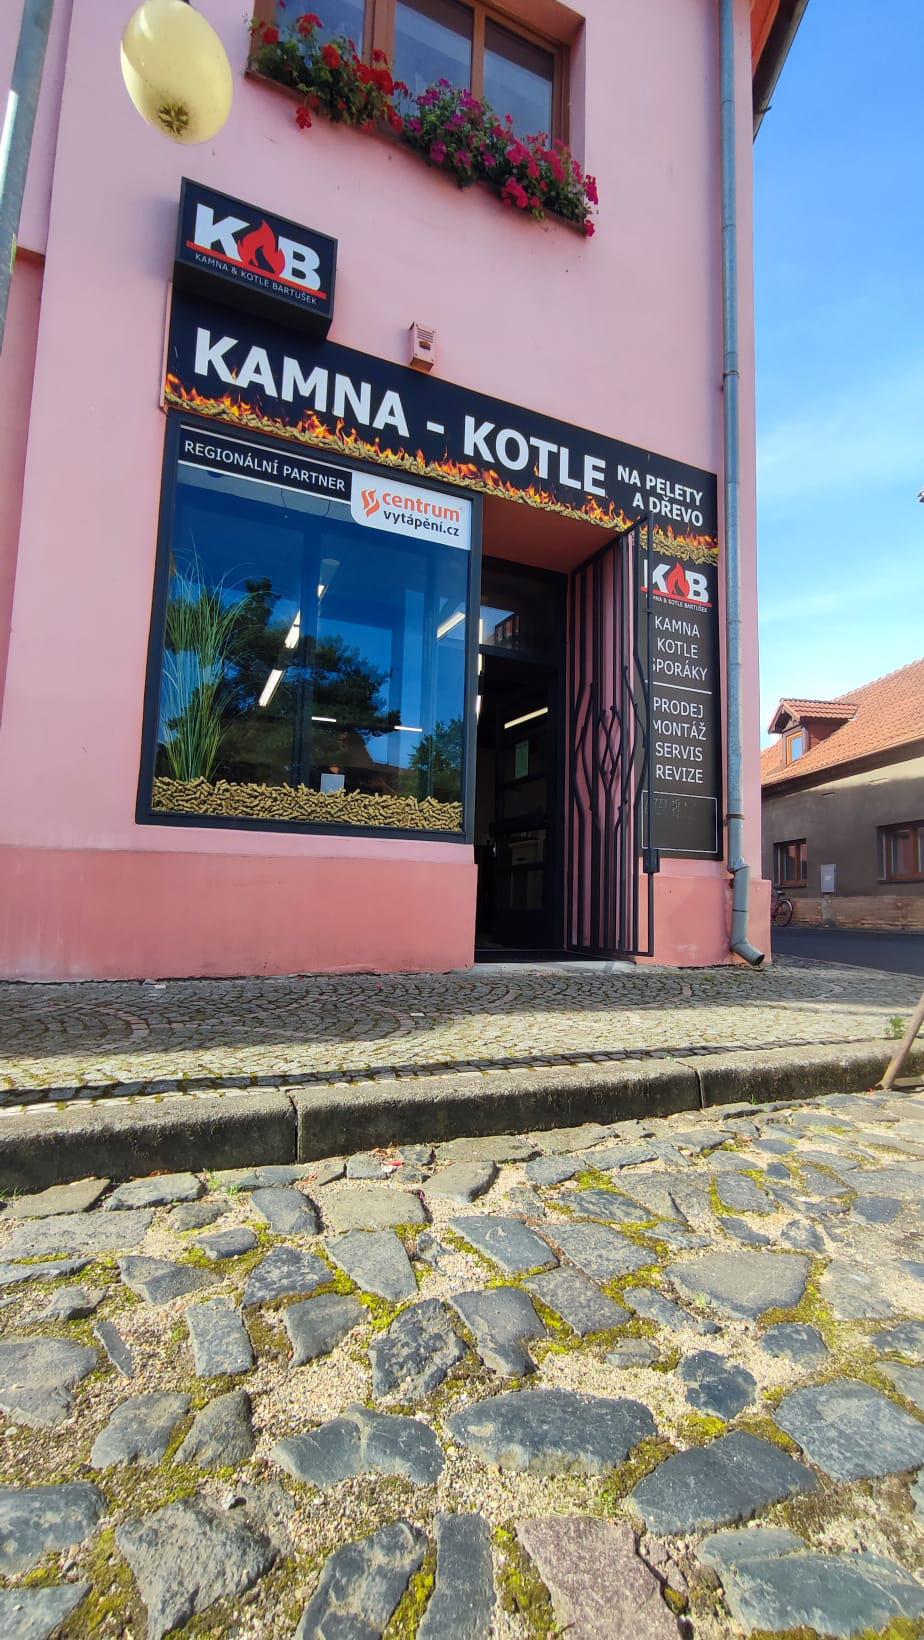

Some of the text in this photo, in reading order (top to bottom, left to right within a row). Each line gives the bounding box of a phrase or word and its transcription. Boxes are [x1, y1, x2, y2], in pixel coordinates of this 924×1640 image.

[195, 253, 318, 305] KAMNA & KOTLE BARTUŠEK
[194, 327, 411, 438] KAMNA
[464, 415, 607, 498] KOTLE
[184, 440, 346, 492] REGIONÁLNÍ PARTNER
[617, 465, 703, 506] NA PELETY
[382, 490, 461, 523] centrum
[632, 492, 704, 527] A DŘEVO
[383, 509, 460, 537] vytápění.cz
[655, 616, 700, 638] KAMNA
[657, 637, 699, 659] KOTLE
[654, 697, 704, 718] PRODEJ
[653, 720, 707, 741] MONTÁŽ
[656, 741, 703, 762] SERVIS
[656, 763, 704, 784] REVIZE
